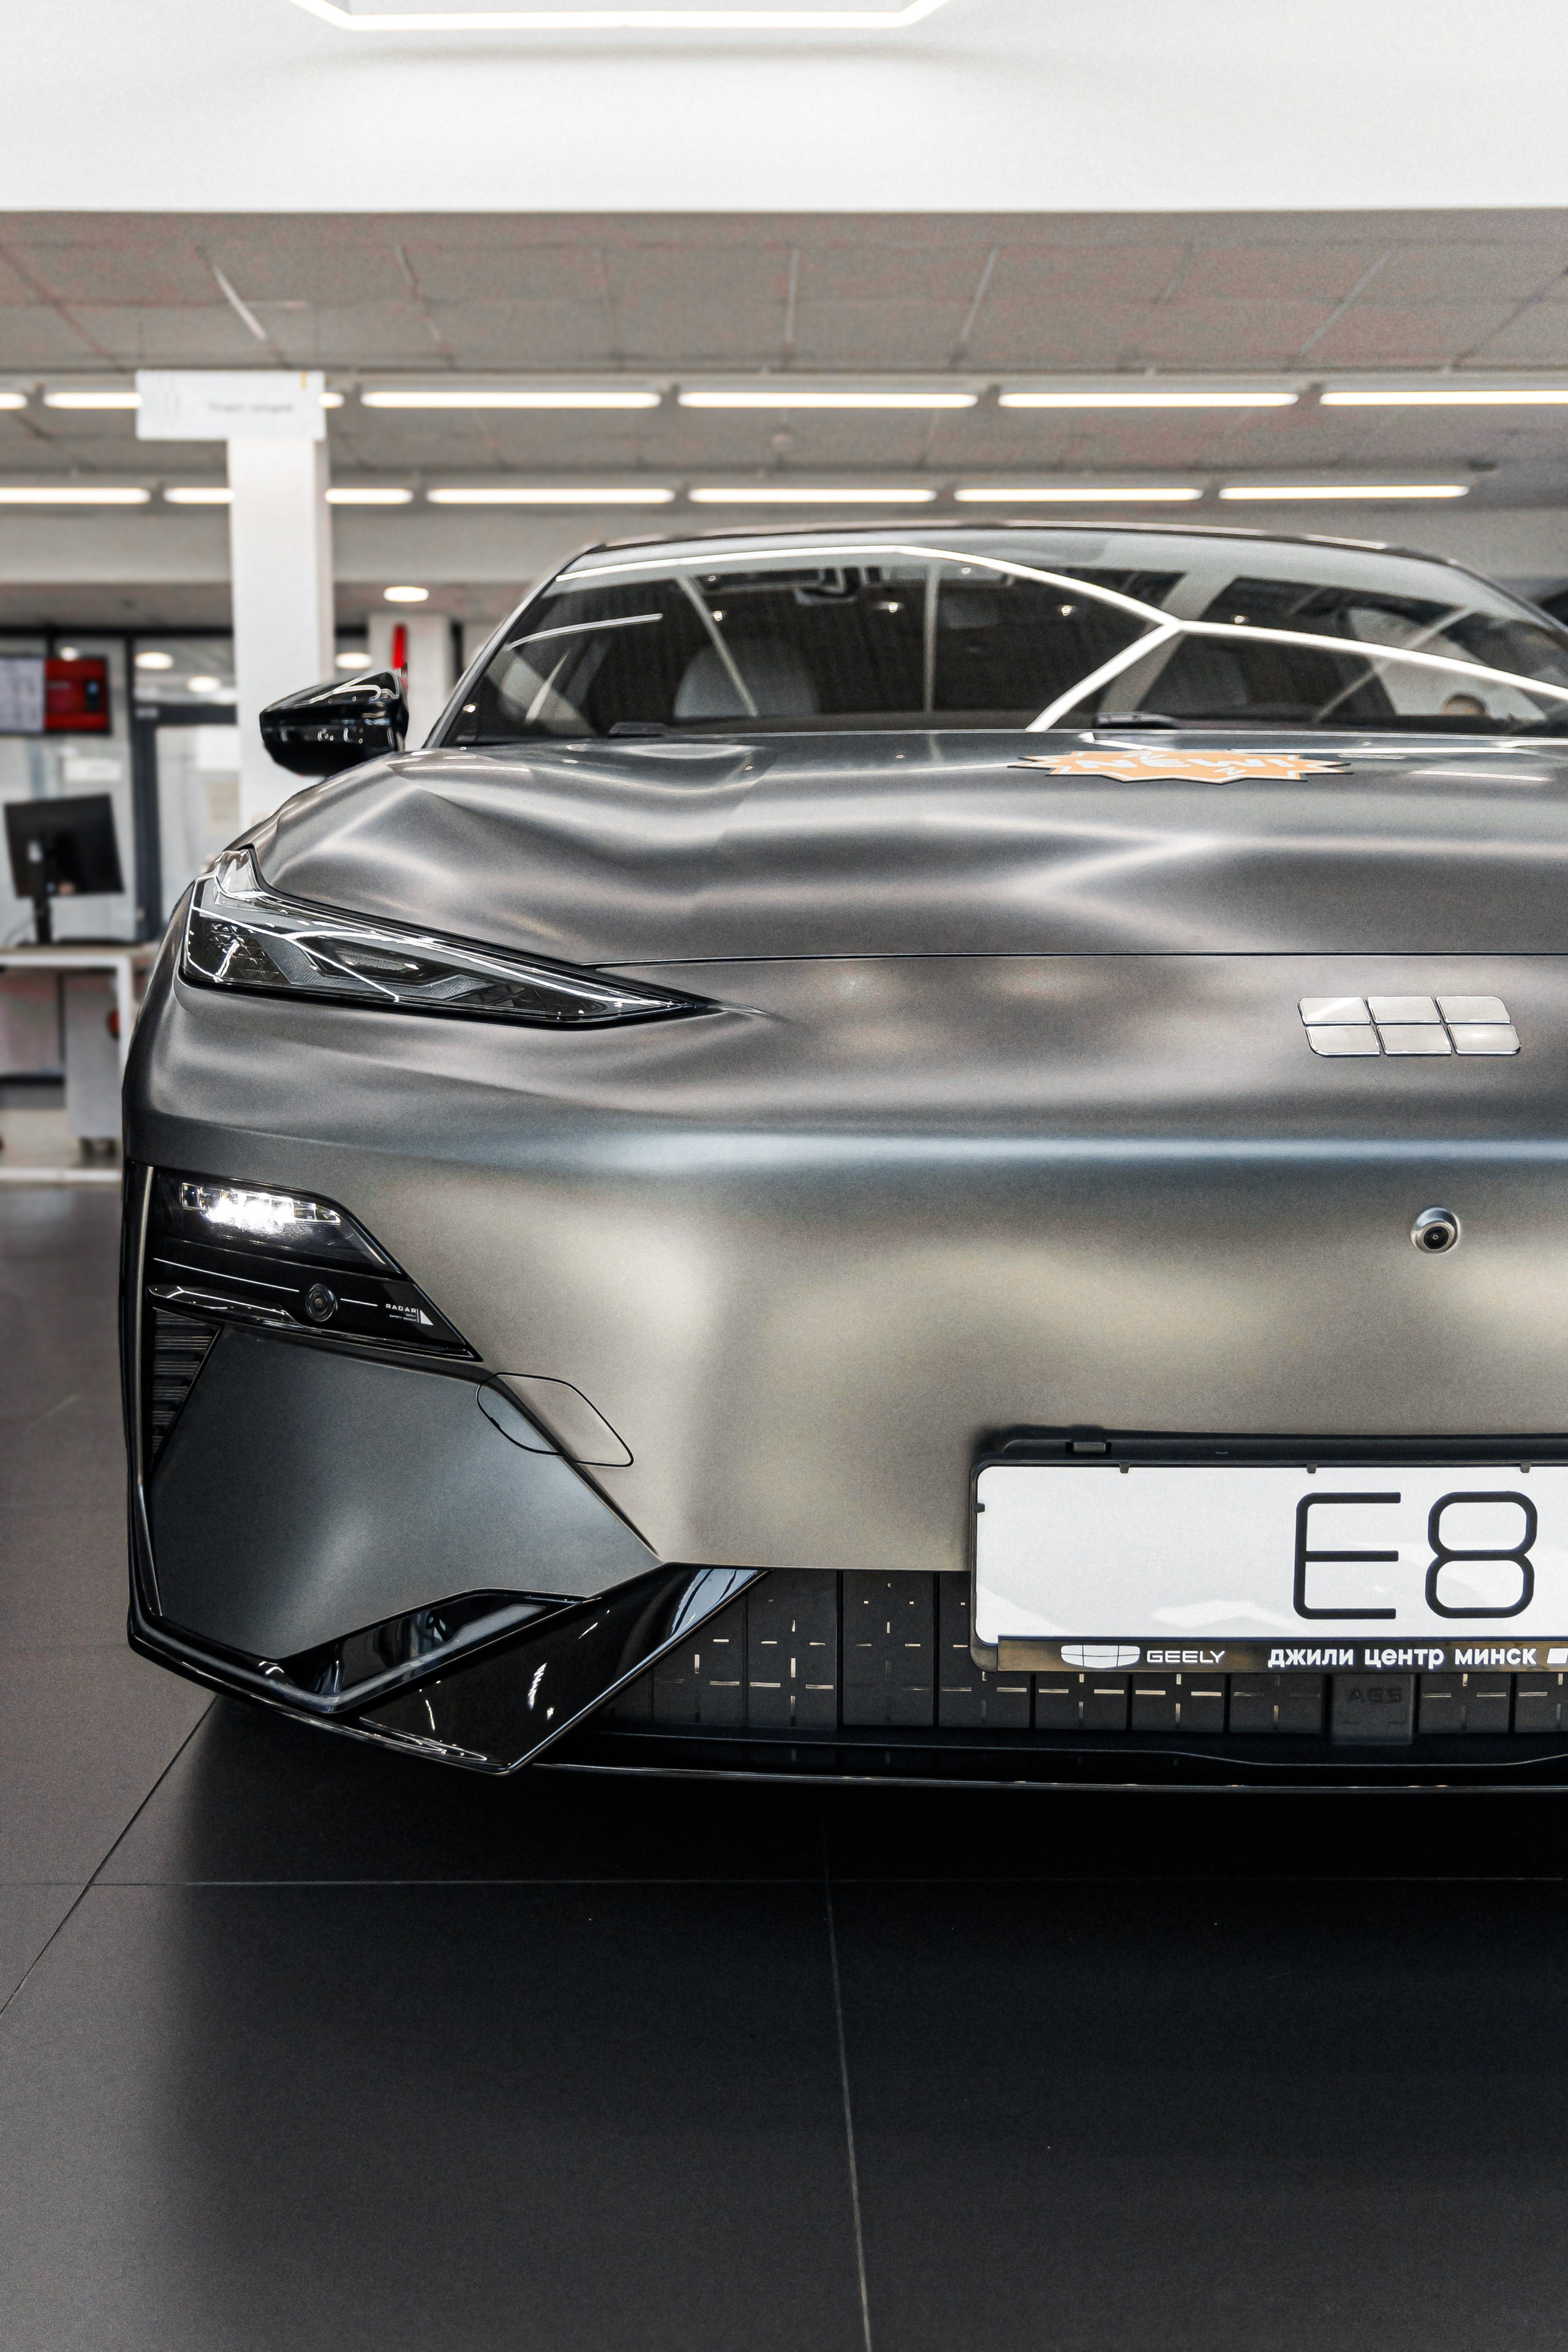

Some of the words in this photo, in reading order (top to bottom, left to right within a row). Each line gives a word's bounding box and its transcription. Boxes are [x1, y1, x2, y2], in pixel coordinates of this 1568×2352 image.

[385, 1303, 417, 1314] RADAR
[1293, 1491, 1538, 1619] E8
[1147, 1650, 1225, 1664] GEELY
[1364, 1648, 1445, 1669] центр
[1454, 1648, 1537, 1665] минск
